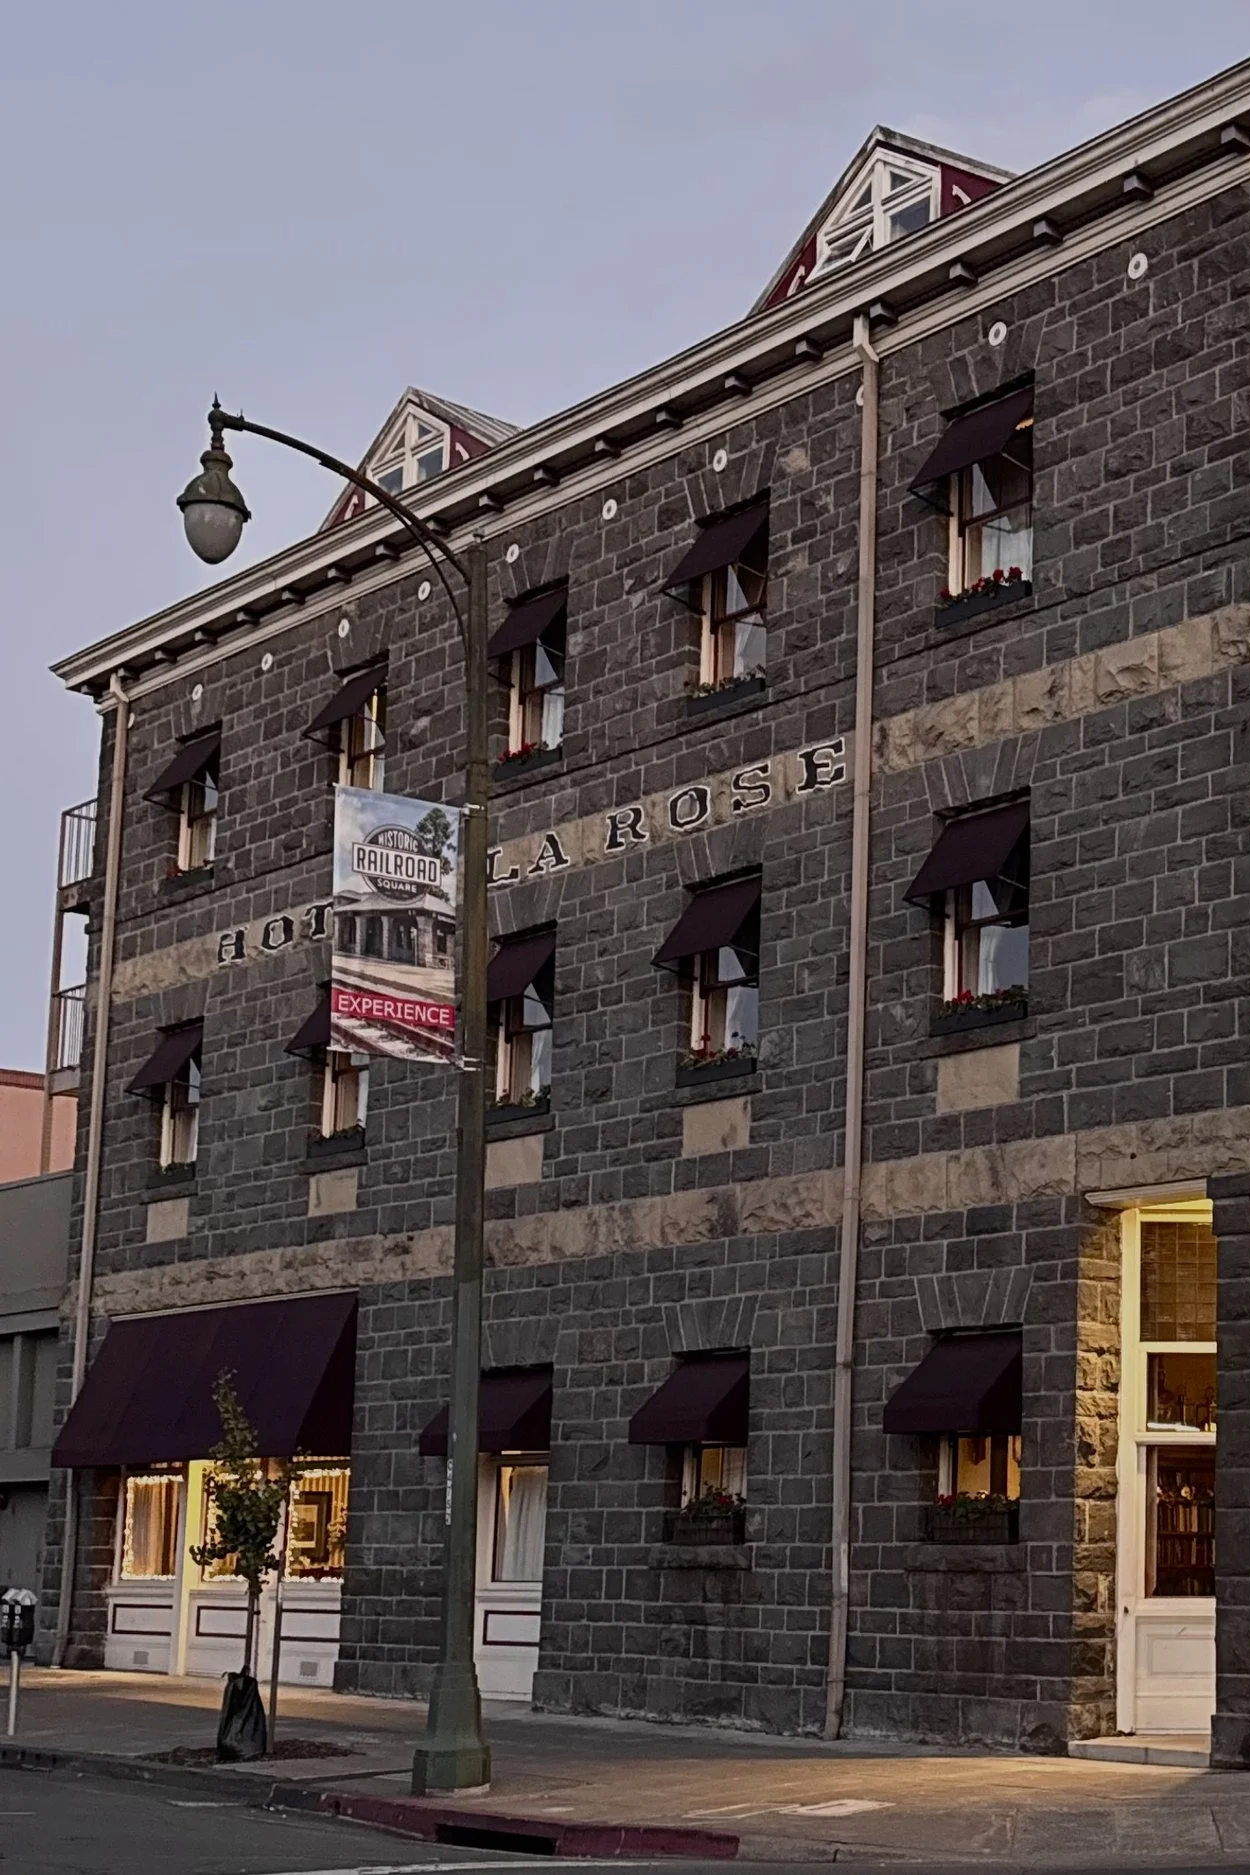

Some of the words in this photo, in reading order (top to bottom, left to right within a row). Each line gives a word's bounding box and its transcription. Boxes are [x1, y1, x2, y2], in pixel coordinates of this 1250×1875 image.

[217, 900, 334, 968] HOT
[487, 832, 571, 887] LA
[605, 737, 846, 853] ROSE
[377, 830, 419, 852] HISTORIC
[356, 847, 437, 882] RAILROAD
[376, 877, 417, 893] SQUARE
[337, 993, 451, 1026] EXPERIENCE
